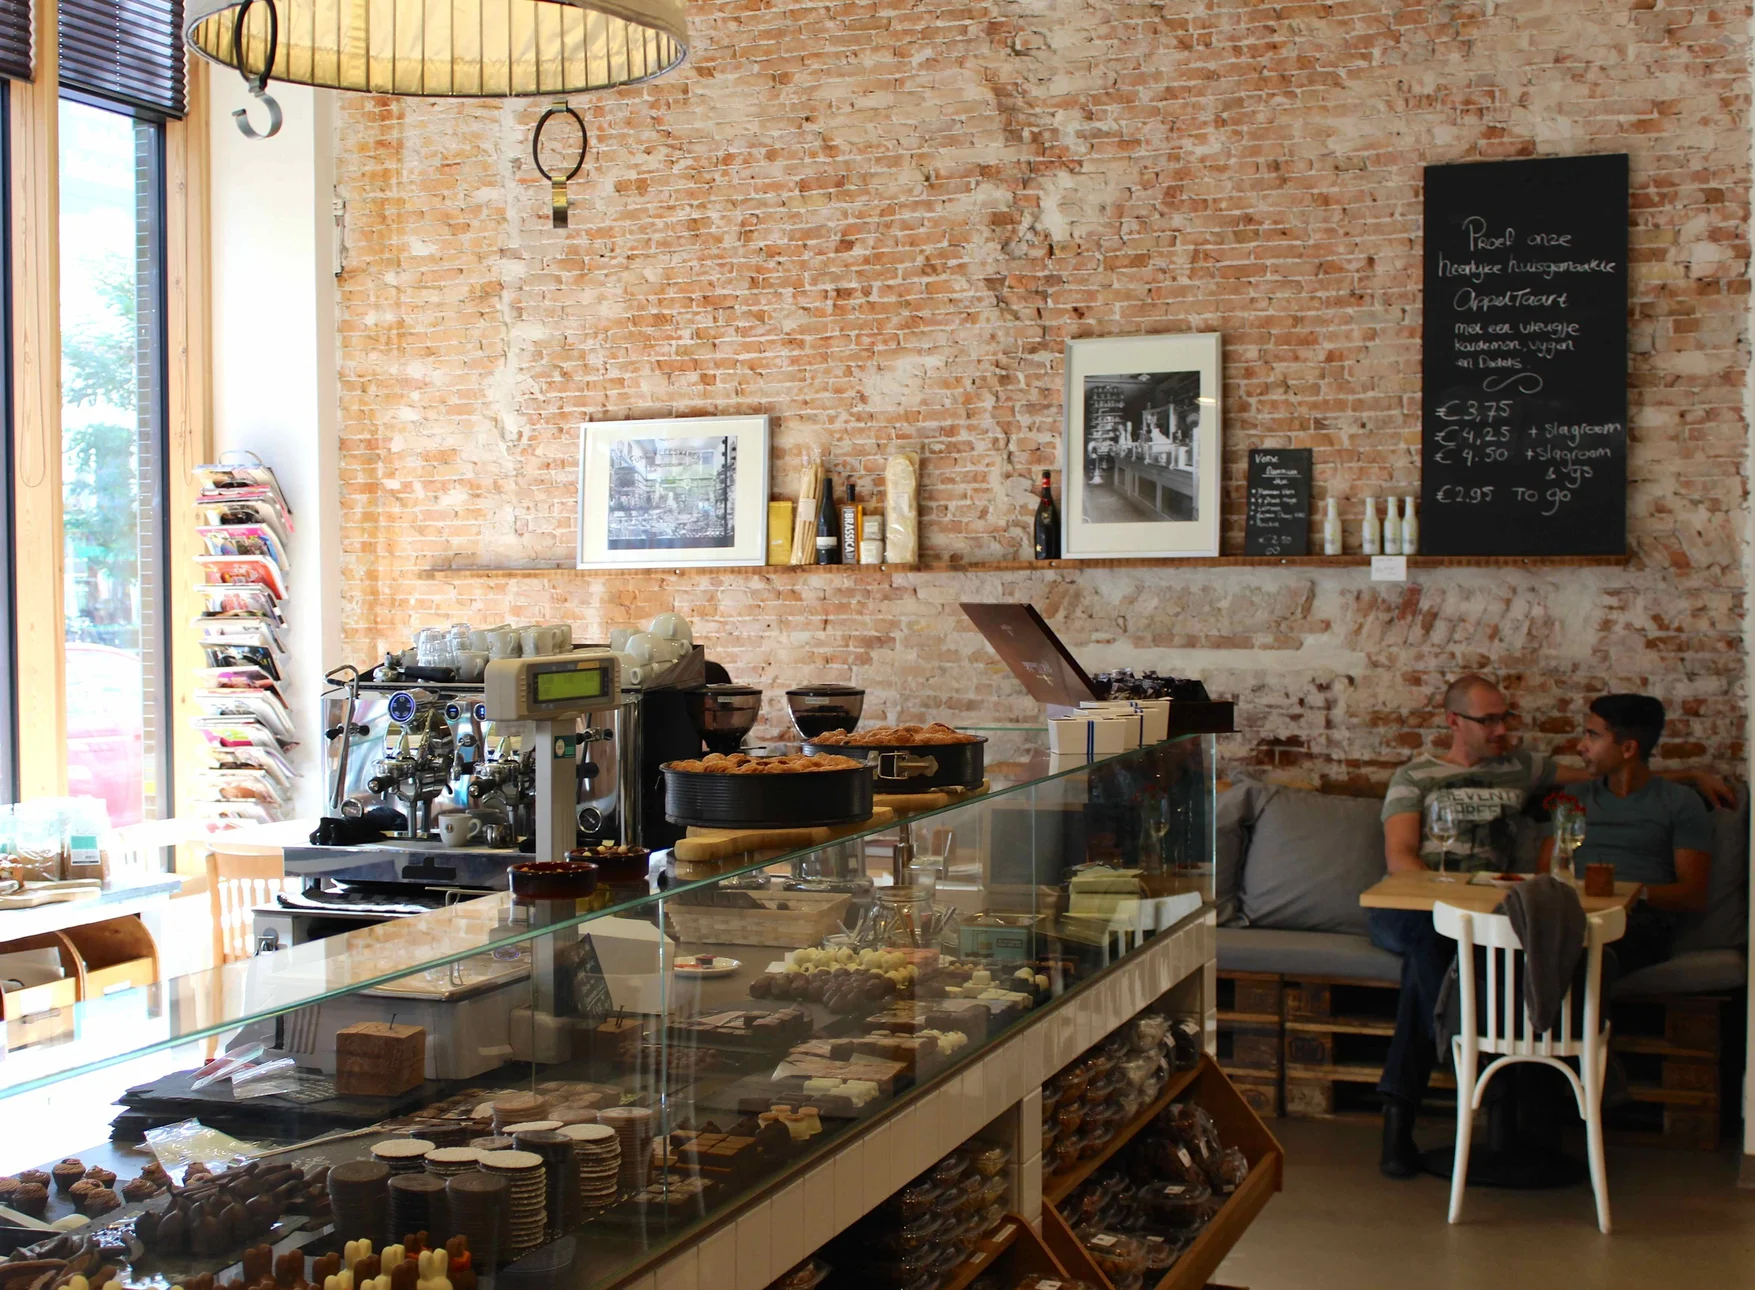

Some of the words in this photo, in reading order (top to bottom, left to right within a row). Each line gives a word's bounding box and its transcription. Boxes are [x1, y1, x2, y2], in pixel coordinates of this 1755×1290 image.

[1527, 233, 1572, 247] onze
[1541, 488, 1571, 516] go
[844, 513, 856, 553] BRASSICA
